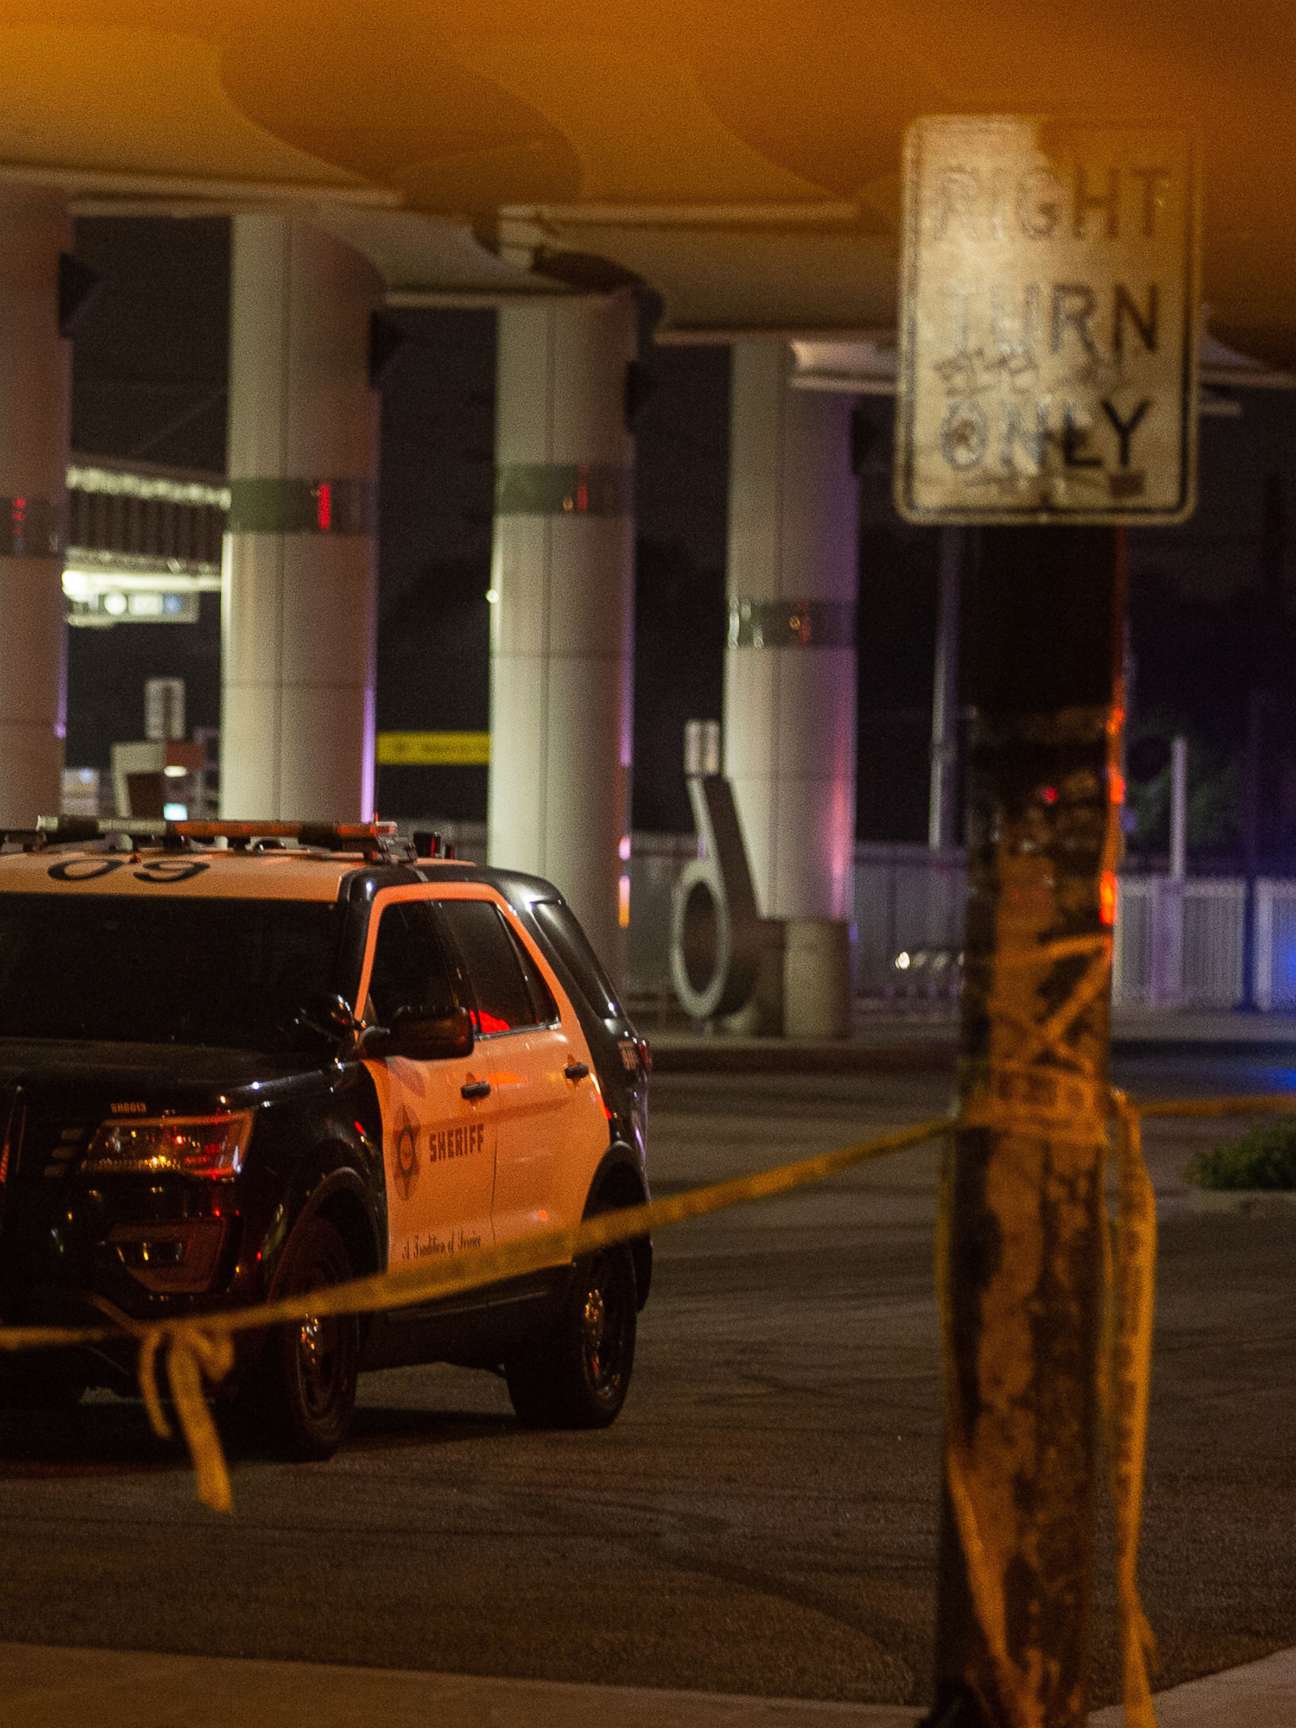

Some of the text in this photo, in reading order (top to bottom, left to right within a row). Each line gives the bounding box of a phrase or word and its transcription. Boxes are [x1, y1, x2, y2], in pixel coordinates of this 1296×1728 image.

[930, 166, 1171, 241] RIGHT
[945, 281, 1159, 358] TURN
[940, 399, 1155, 472] ONLY
[429, 1124, 484, 1162] SHERIFF
[413, 1232, 446, 1258] Tradition
